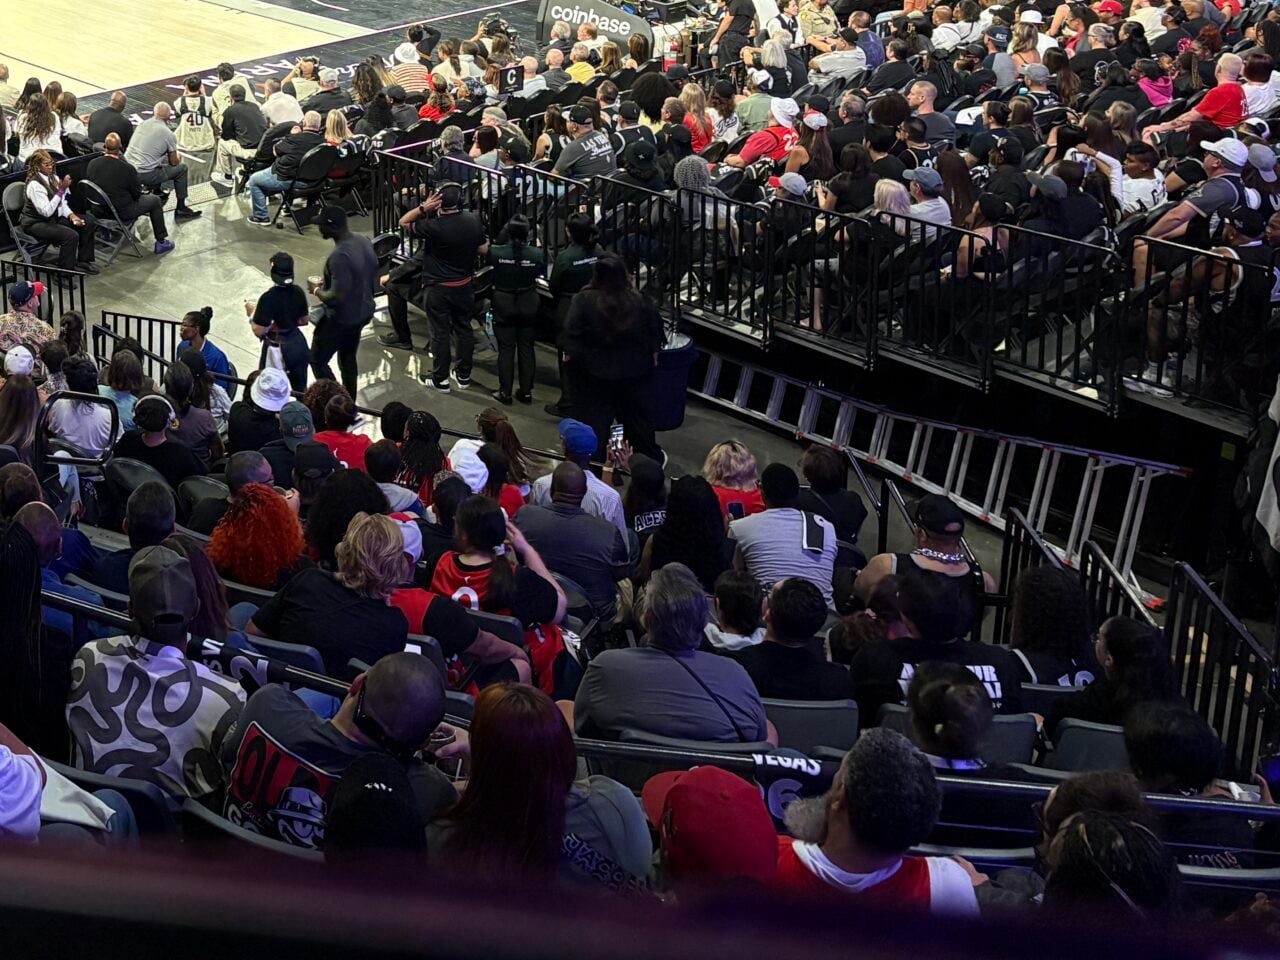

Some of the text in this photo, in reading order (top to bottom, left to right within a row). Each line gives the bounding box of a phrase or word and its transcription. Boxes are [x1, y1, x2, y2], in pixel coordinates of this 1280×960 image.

[551, 5, 631, 35] coinbase
[507, 69, 516, 85] C
[752, 752, 823, 777] VEGAS
